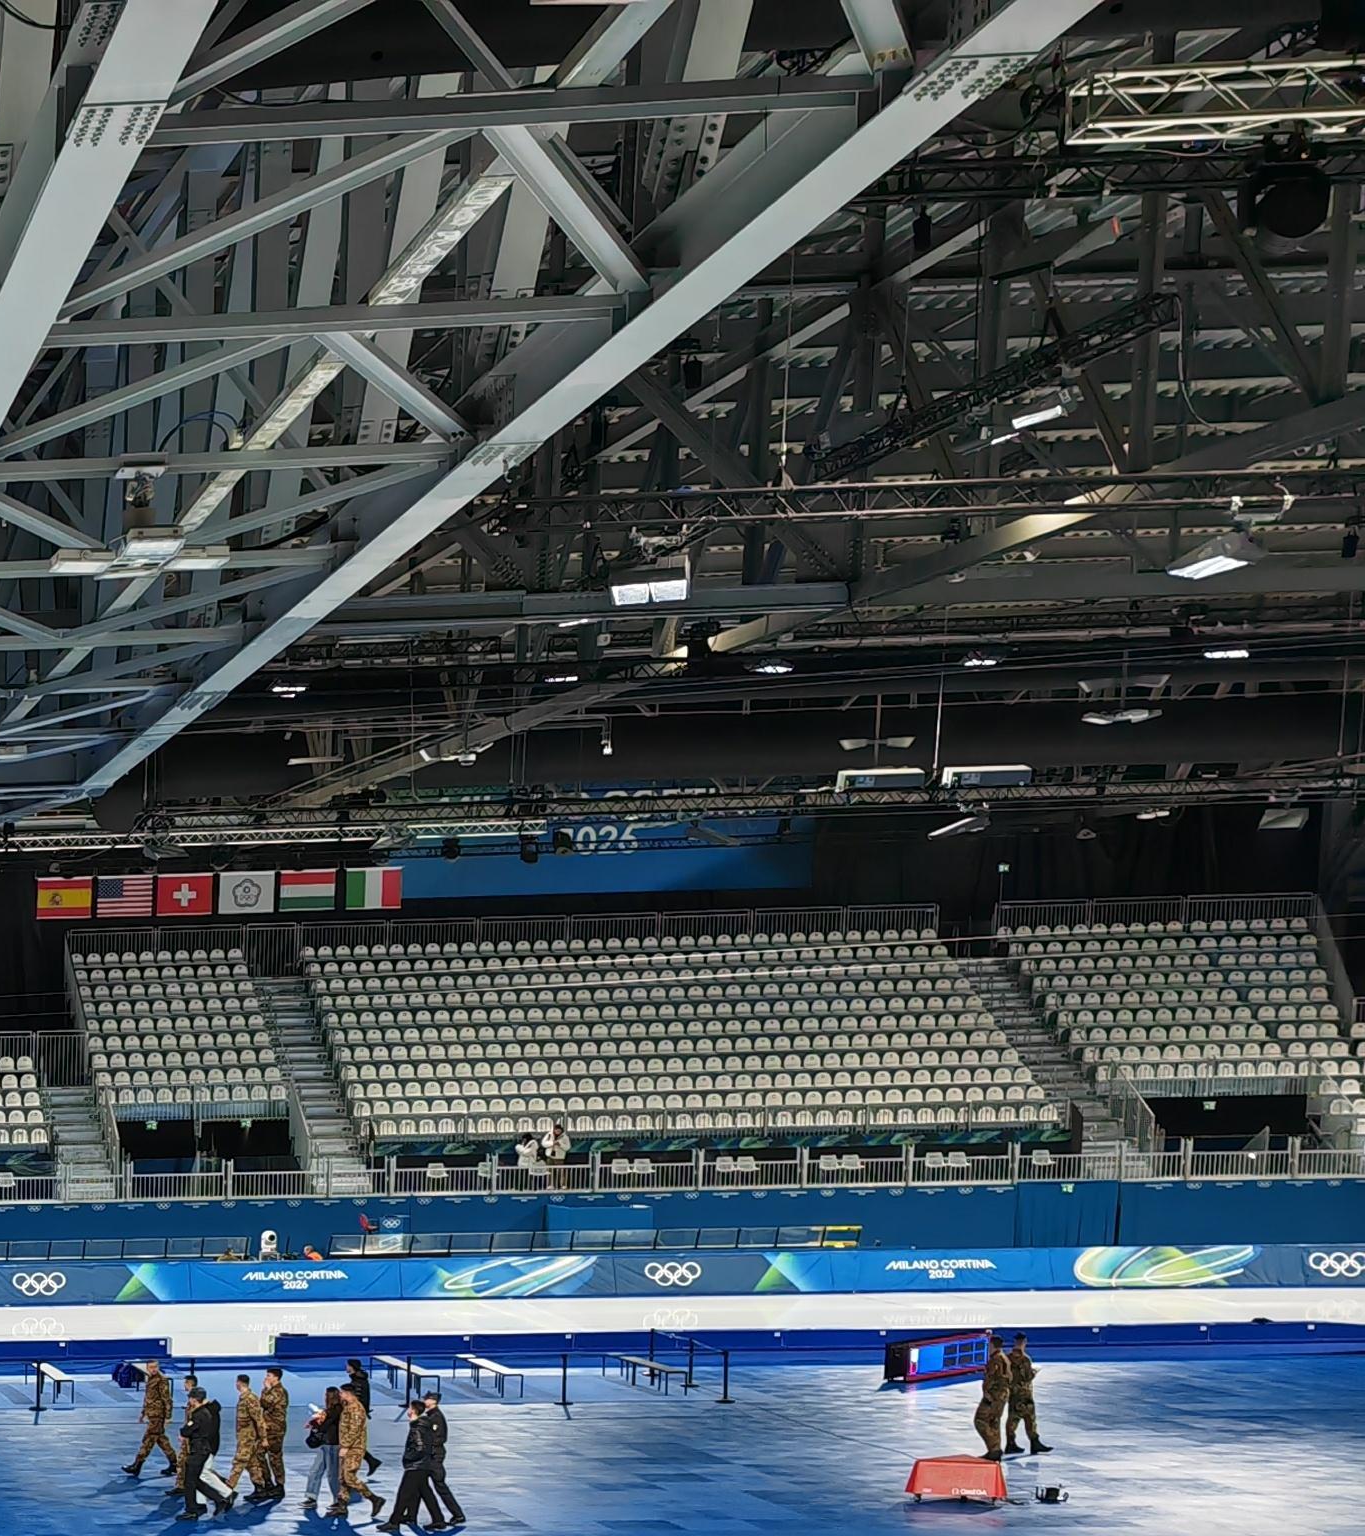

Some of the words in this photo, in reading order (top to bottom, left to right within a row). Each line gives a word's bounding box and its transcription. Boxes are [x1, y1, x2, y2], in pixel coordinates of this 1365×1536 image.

[884, 1258, 939, 1270] MILANO
[941, 1258, 996, 1270] CORTINA
[242, 1269, 293, 1281] MILANO
[295, 1269, 348, 1281] CORTINA
[928, 1269, 955, 1279] 2026
[283, 1279, 309, 1290] 2026
